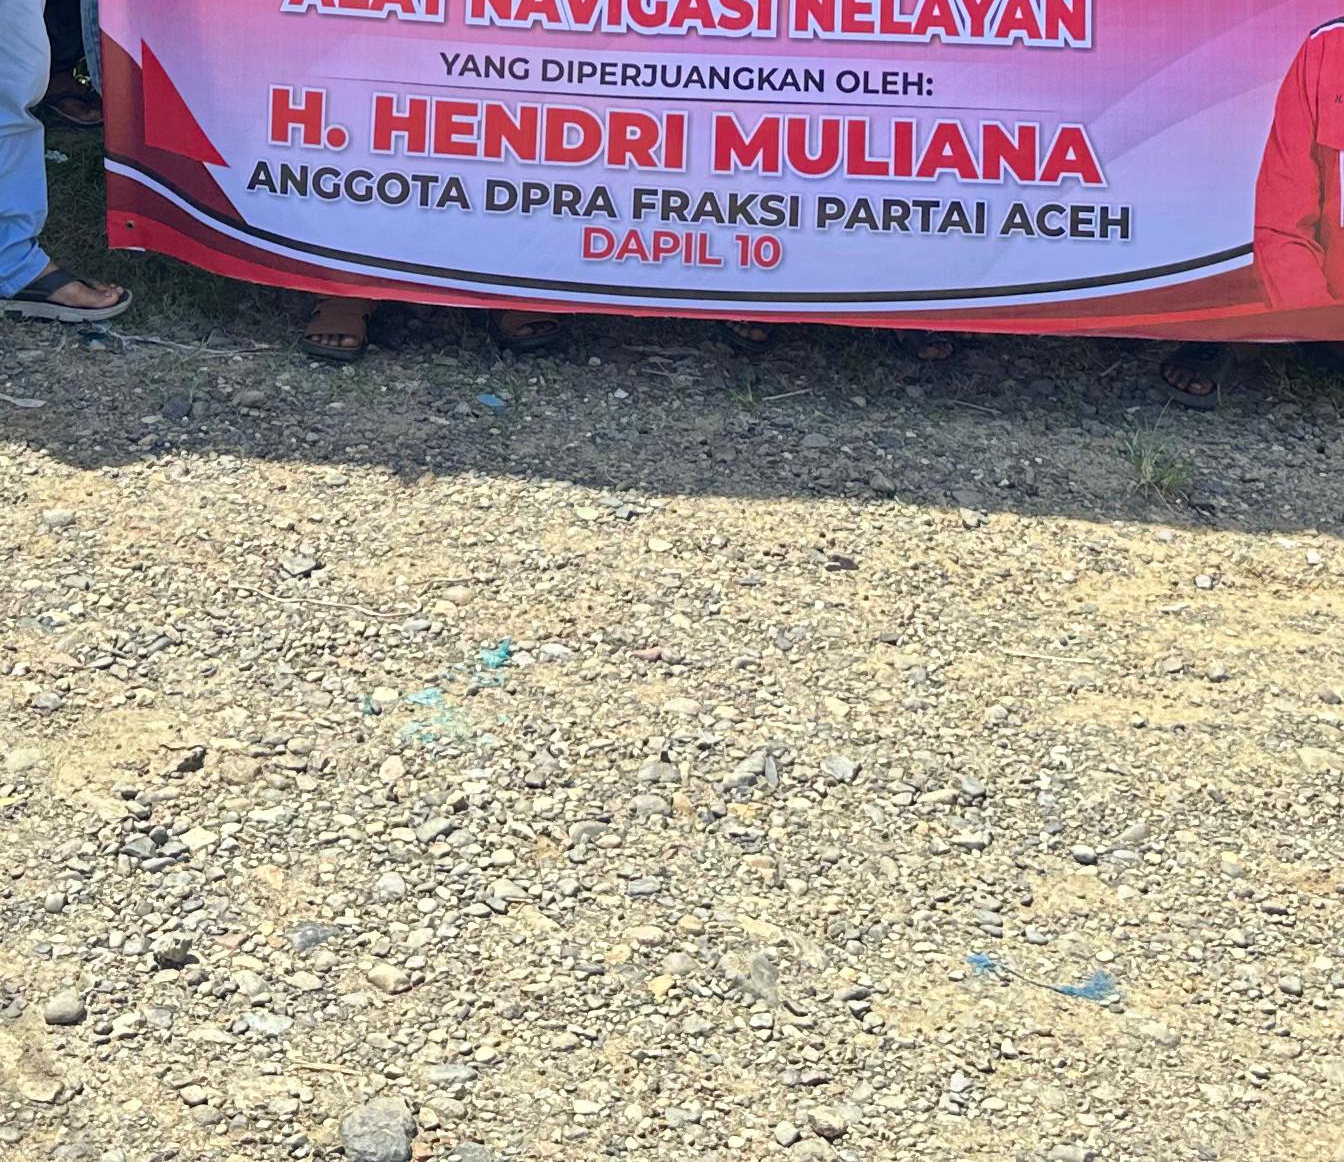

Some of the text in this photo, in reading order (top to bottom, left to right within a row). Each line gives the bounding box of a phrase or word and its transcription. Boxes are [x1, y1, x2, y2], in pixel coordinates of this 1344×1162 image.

[440, 52, 934, 97] YANG DIPERJUANGKAN OLEH:
[270, 89, 1105, 184] H. HENDRI MULIANA
[247, 164, 1131, 240] ANGGOTA DPRA FRAKSI PARTAI ACEH
[582, 228, 782, 269] DAPIL 10
